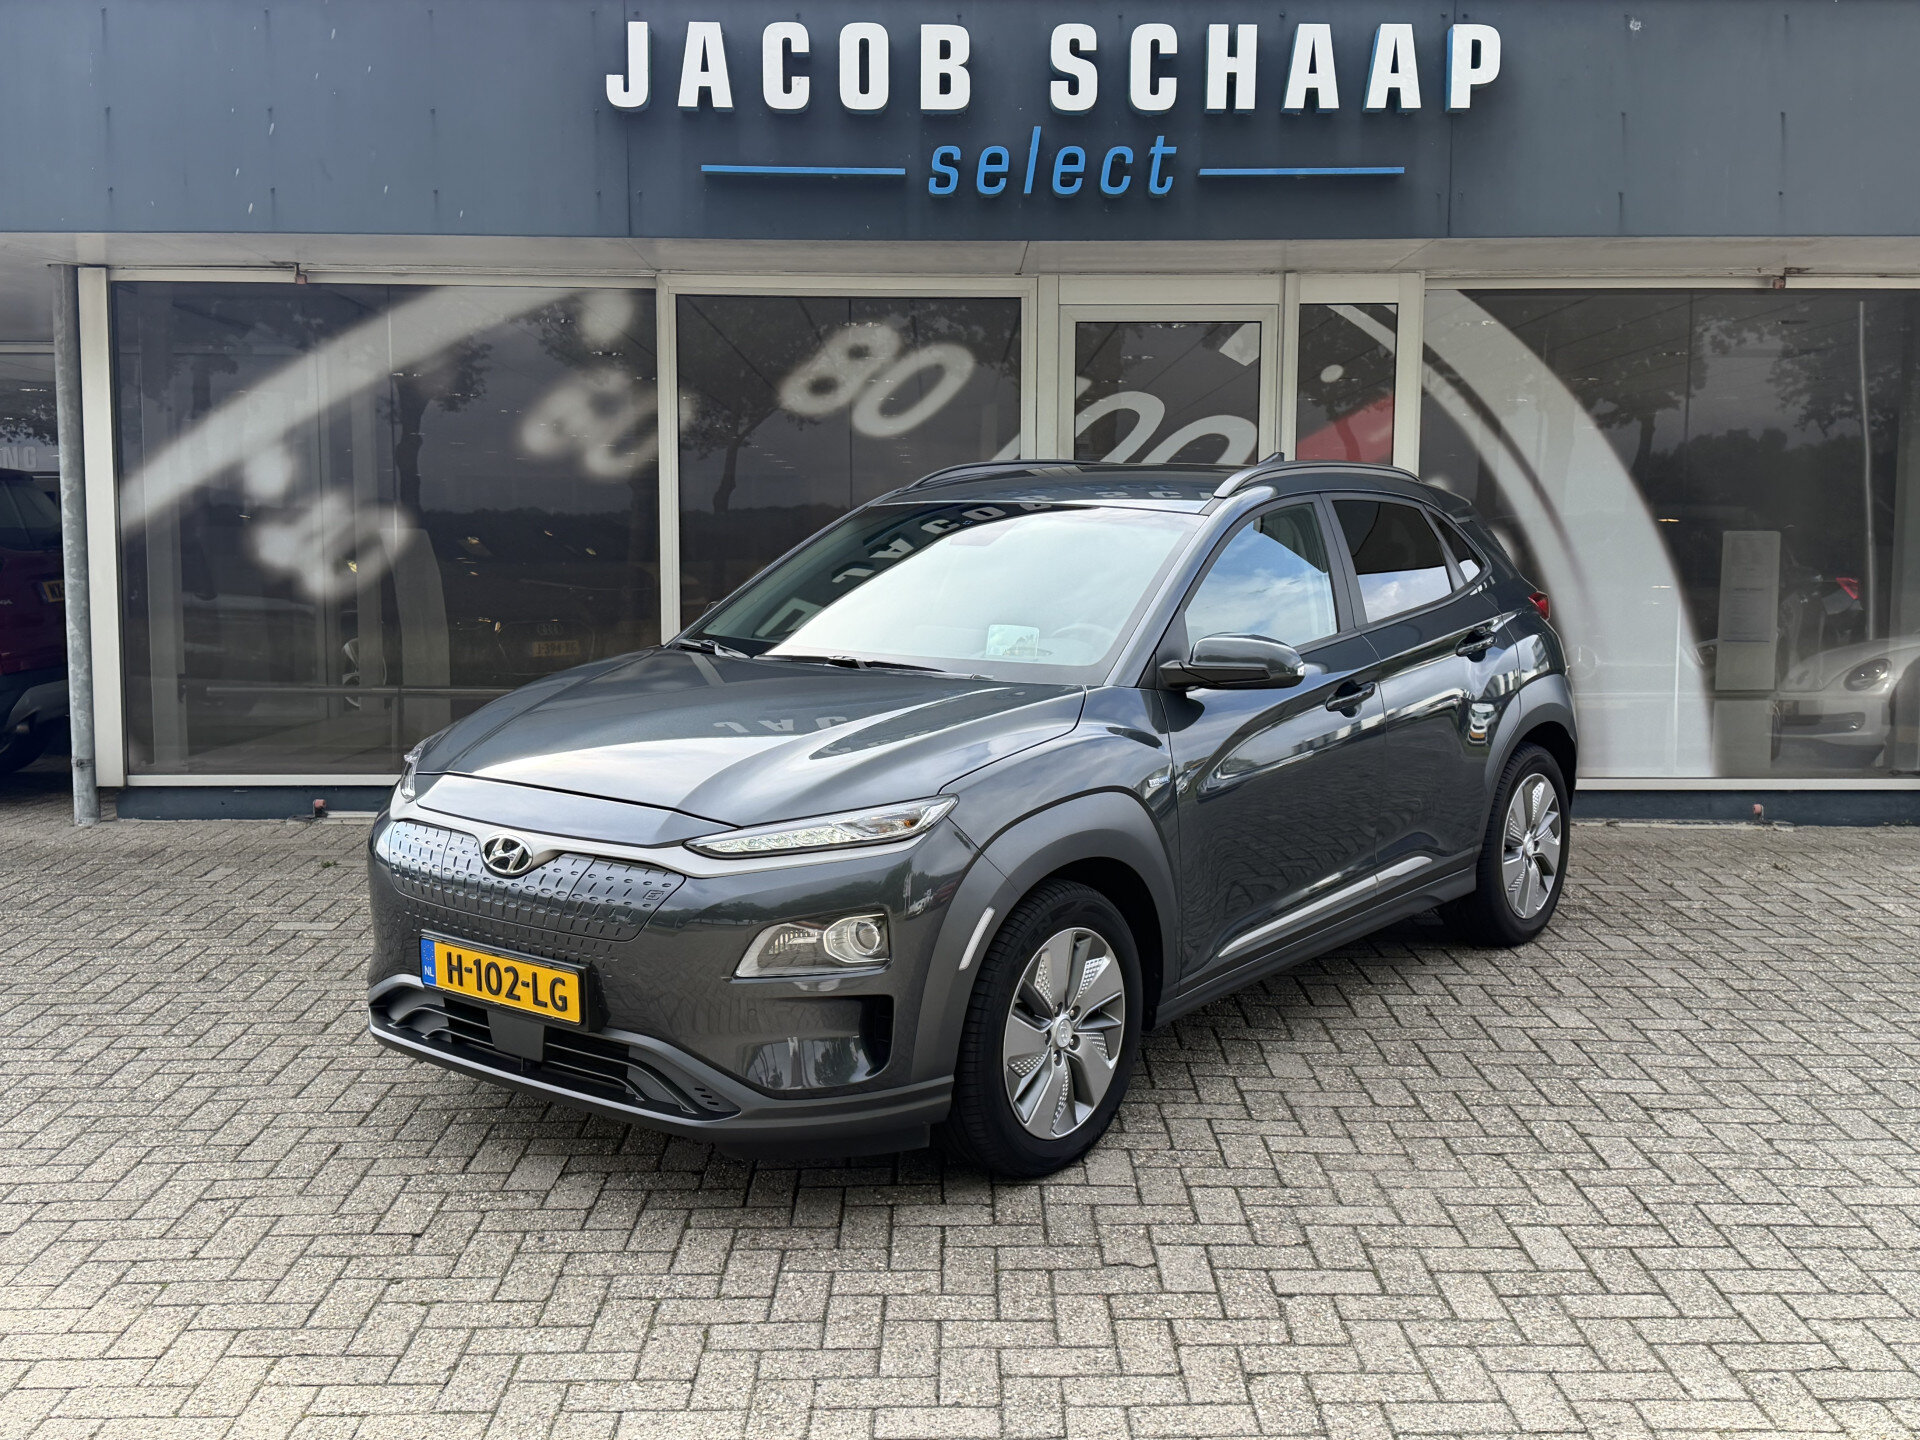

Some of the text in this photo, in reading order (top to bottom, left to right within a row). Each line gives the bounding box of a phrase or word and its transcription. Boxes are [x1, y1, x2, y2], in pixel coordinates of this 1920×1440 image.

[606, 20, 1502, 114] JACOB SCHAAP
[928, 125, 1178, 197] select
[778, 322, 976, 438] 80
[424, 951, 568, 1012] NL H-102-LG
